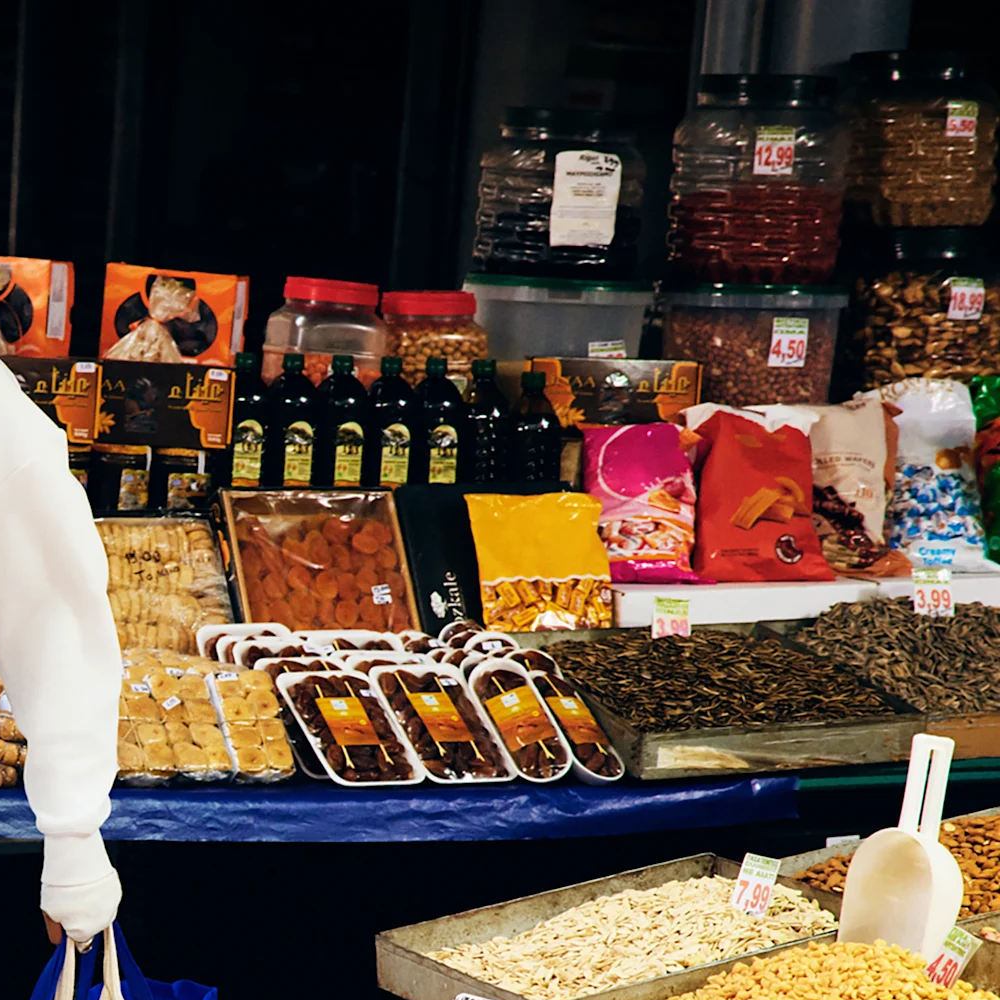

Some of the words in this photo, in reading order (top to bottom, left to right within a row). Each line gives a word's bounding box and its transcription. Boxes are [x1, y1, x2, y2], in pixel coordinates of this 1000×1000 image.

[756, 145, 793, 171] 12,99
[771, 338, 805, 363] 4,50
[916, 589, 951, 612] 3,99
[736, 880, 770, 911] 7,99
[926, 953, 959, 988] 4,50
